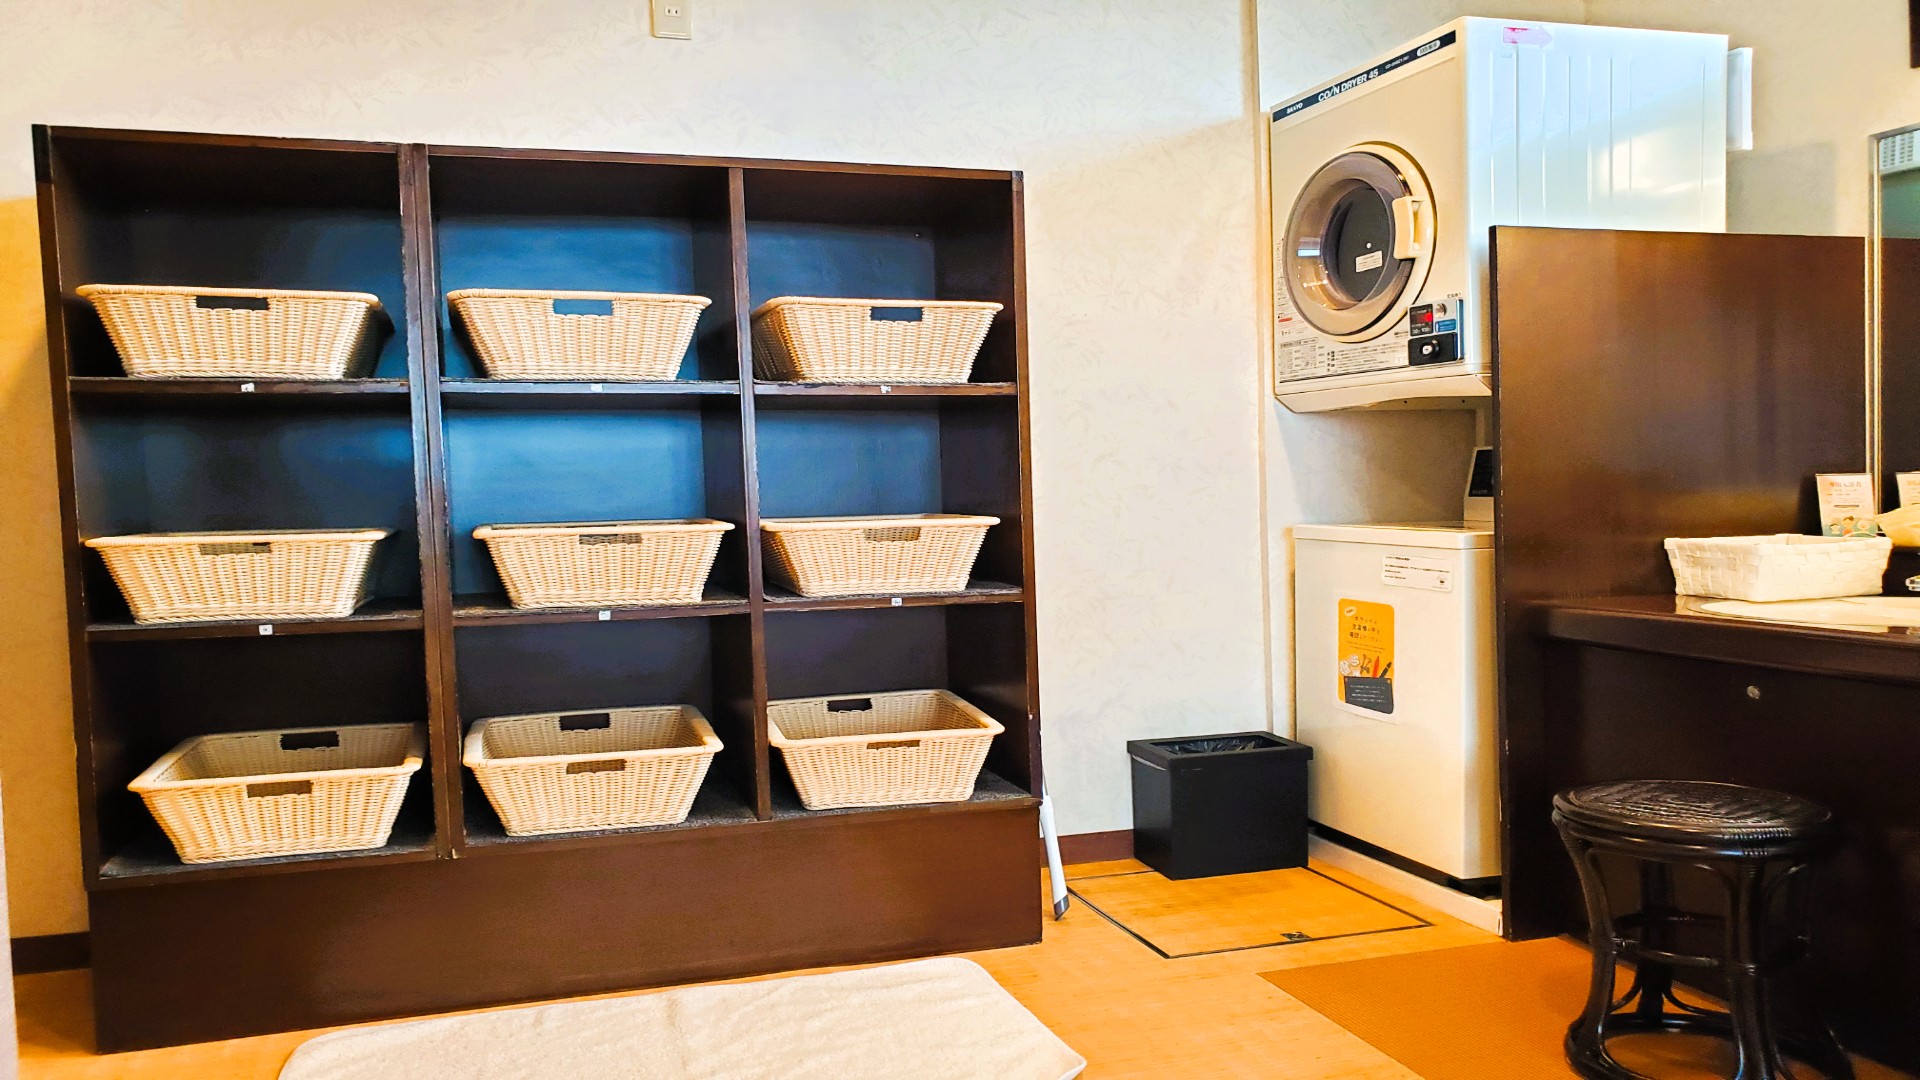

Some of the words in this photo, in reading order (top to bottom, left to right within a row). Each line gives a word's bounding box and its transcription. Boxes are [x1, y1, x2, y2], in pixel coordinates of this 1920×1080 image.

[1318, 85, 1340, 102] COIN
[1341, 74, 1367, 91] DRYER
[1368, 69, 1379, 79] 45
[1286, 103, 1303, 114] SANYO
